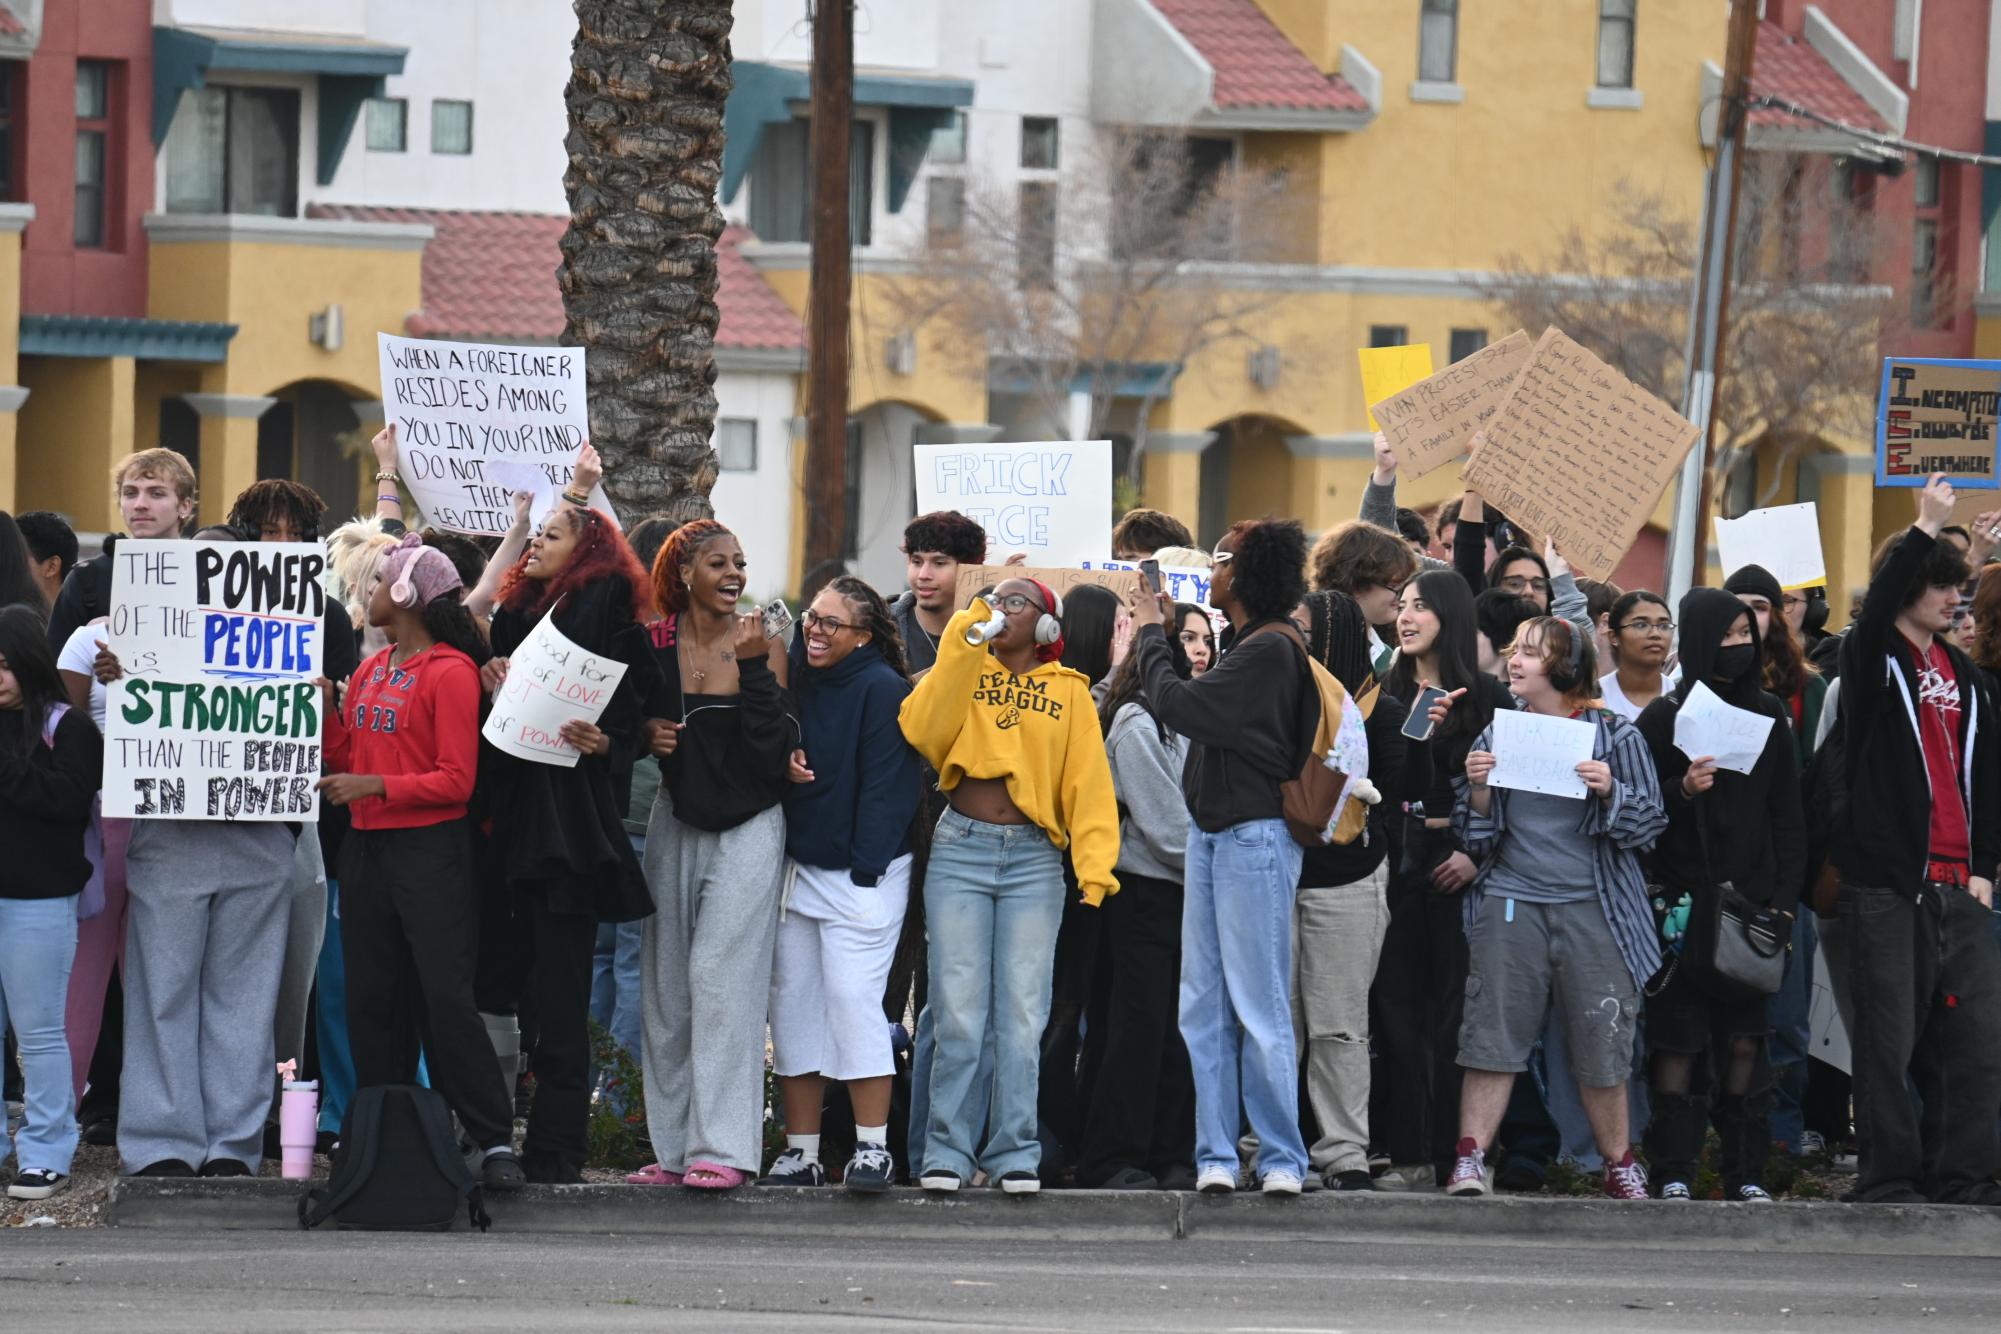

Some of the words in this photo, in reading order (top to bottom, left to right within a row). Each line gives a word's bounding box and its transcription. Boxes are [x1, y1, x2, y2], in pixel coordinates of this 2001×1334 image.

[449, 350, 464, 370] A
[467, 349, 572, 379] FOREIGNER
[1417, 352, 1484, 402] PROTEST
[395, 377, 489, 412] RESIDES
[497, 383, 567, 414] AMONG
[1429, 389, 1480, 423] EASIER
[400, 416, 440, 446] YOU
[446, 421, 474, 450] IN
[479, 424, 537, 455] YOUR
[539, 424, 582, 454] LAND
[1406, 447, 1417, 460] A
[1419, 428, 1455, 451] FAMILY
[409, 450, 444, 481] DO
[449, 457, 485, 483] NOT
[934, 452, 1073, 496] FRICK
[966, 504, 1049, 546] ICE
[119, 551, 179, 585] THE
[196, 547, 324, 617] POWER
[113, 604, 148, 637] OF
[159, 605, 197, 639] THE
[204, 613, 316, 672] PEOPLE
[533, 666, 555, 682] of
[555, 676, 606, 705] LOVE
[580, 657, 616, 682] for
[979, 671, 1048, 695] TEAM
[121, 678, 318, 738] STRONGER
[972, 687, 1063, 721] PRAGUE
[492, 715, 516, 733] of
[114, 738, 183, 769] THAN
[191, 738, 233, 769] THE
[243, 740, 320, 775] PEOPLE
[133, 777, 185, 815] IN
[206, 776, 312, 823] POWER
